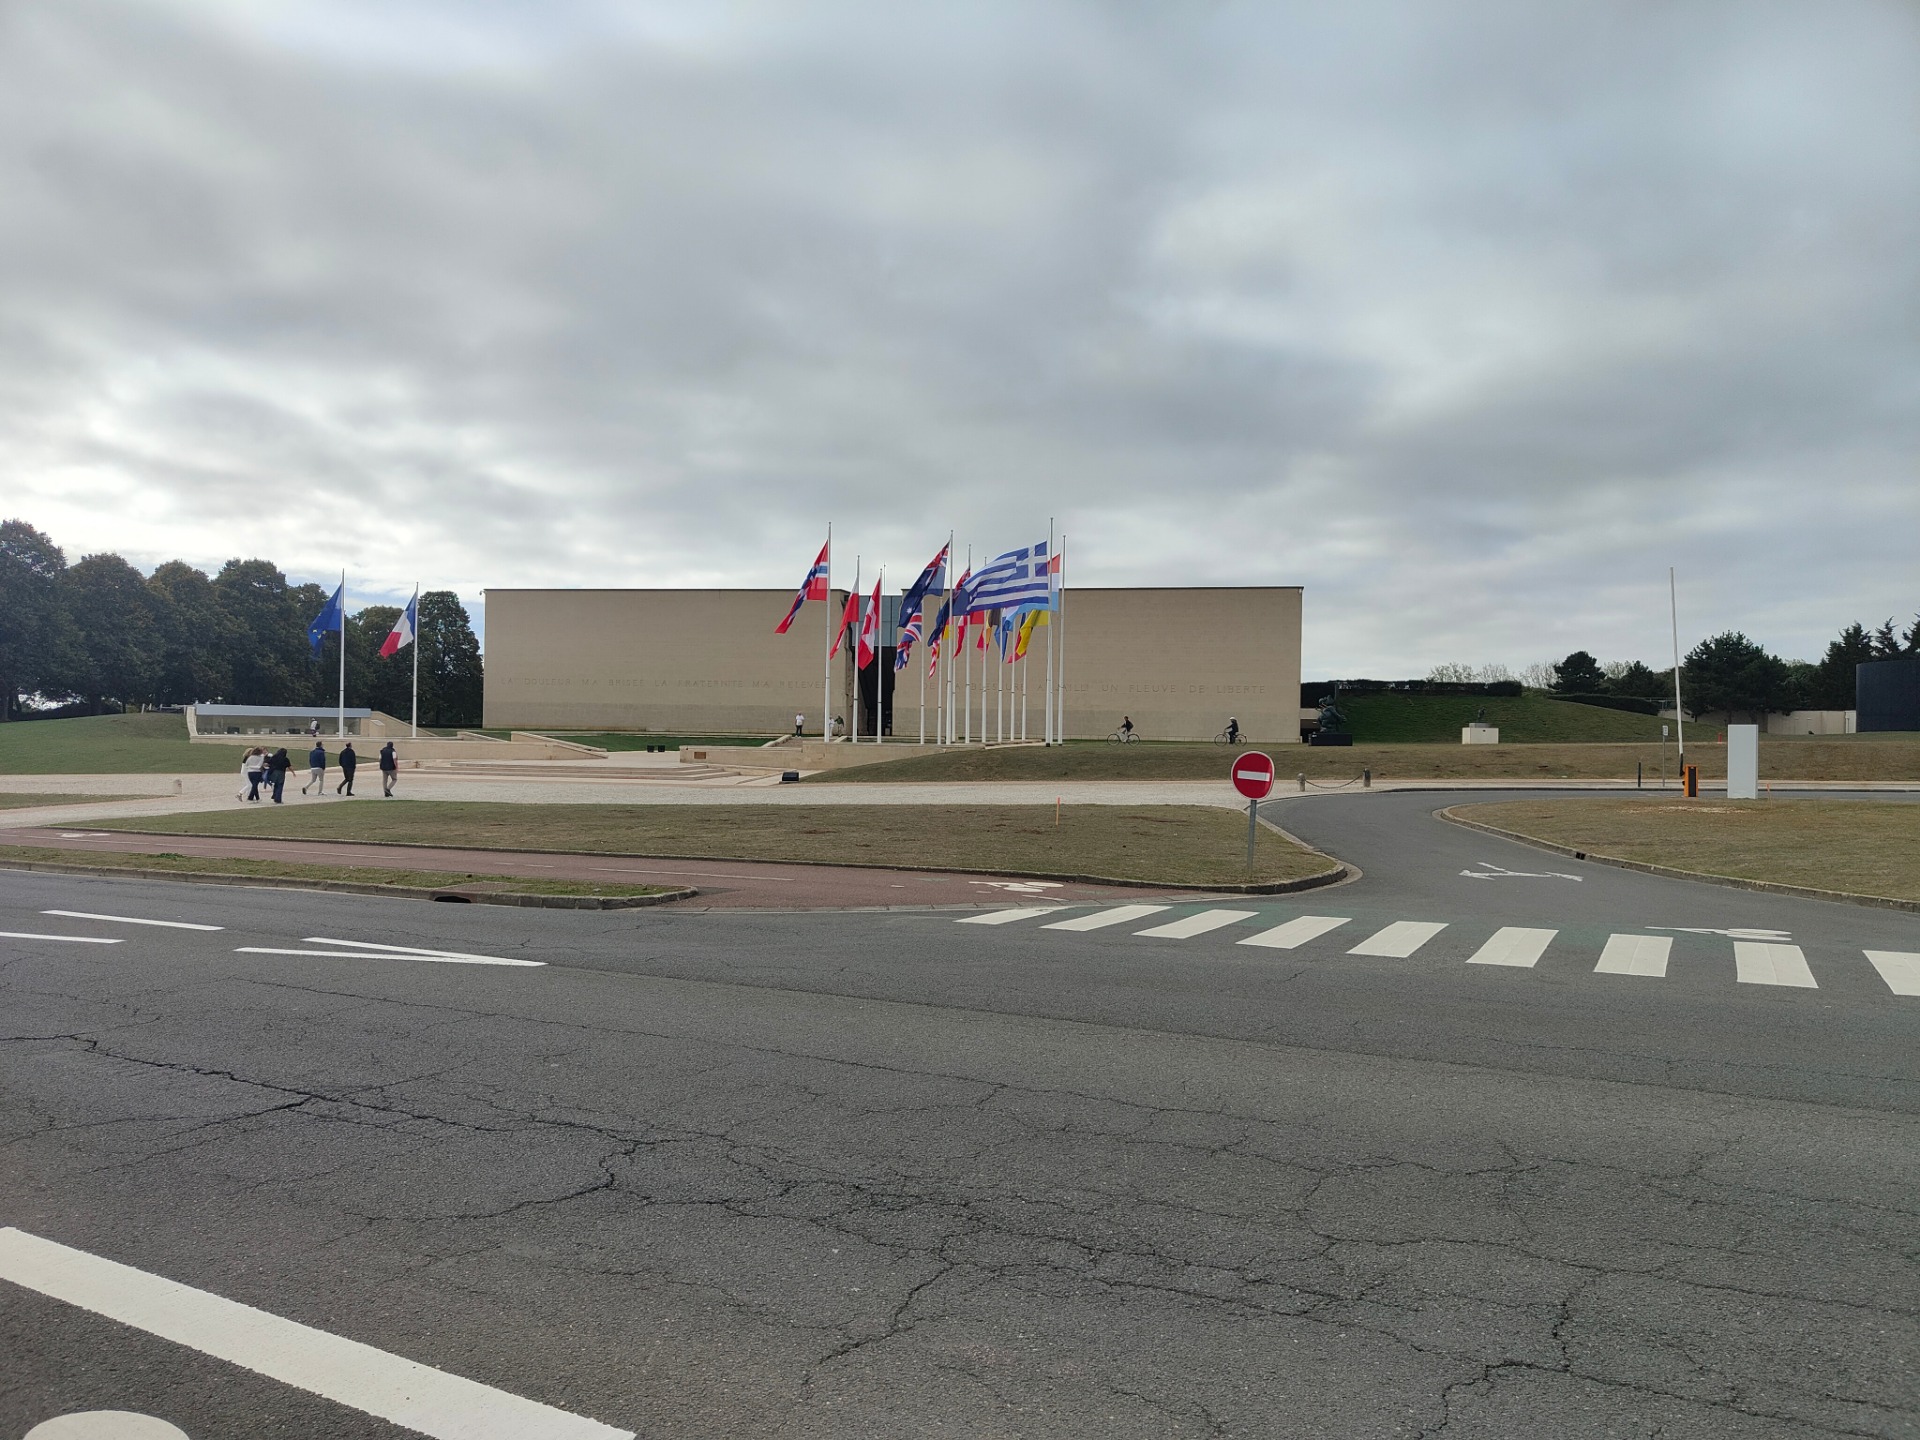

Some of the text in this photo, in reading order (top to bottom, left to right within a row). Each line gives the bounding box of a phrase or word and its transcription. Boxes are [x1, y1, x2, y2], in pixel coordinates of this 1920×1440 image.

[523, 677, 572, 687] DOULEUR
[654, 679, 668, 688] LA
[677, 679, 744, 689] FRATERNITE
[778, 680, 827, 690] RELEVEE
[1101, 683, 1119, 693] UN
[1128, 683, 1177, 693] FLEUVE
[1188, 684, 1206, 694] DE
[1216, 684, 1266, 694] LIBERTE
